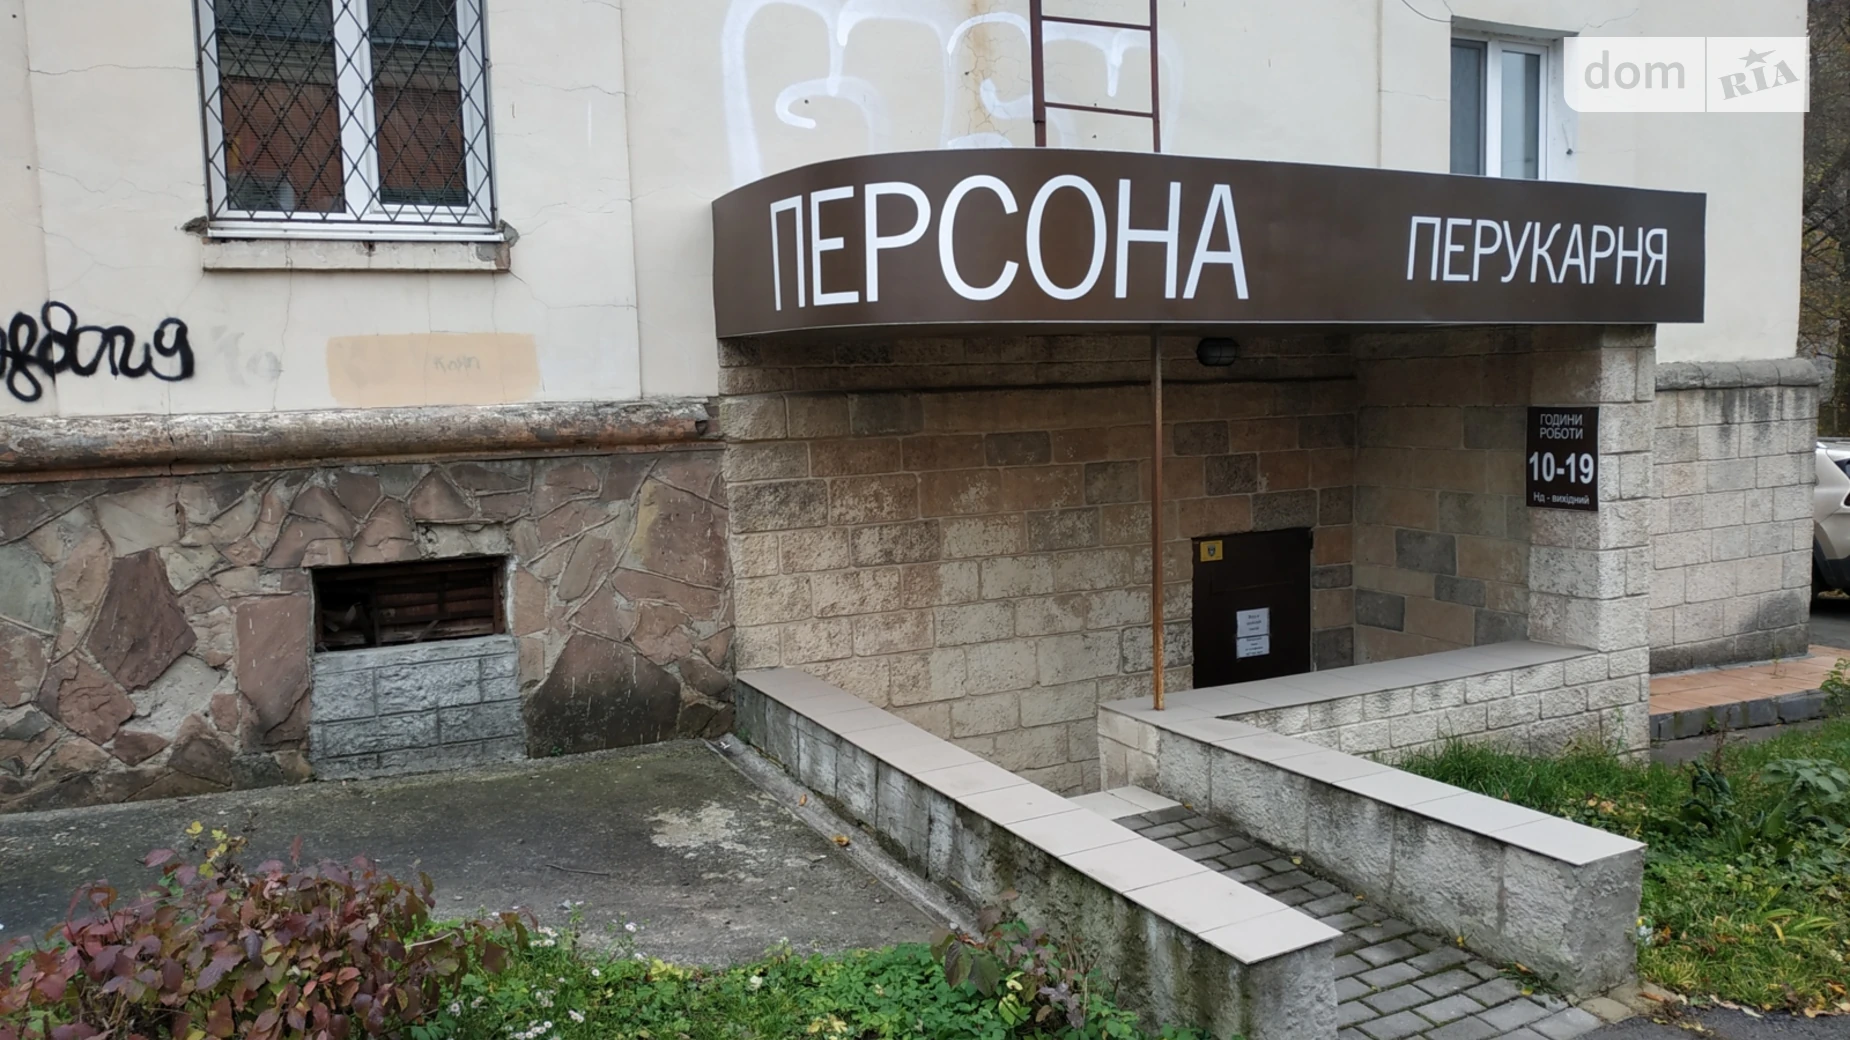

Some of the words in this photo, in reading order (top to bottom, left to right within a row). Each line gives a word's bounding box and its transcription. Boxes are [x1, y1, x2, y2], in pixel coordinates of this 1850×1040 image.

[769, 174, 1250, 311] ПЕРСОНА
[1405, 215, 1669, 286] ПЕРУКАРНЯ
[1540, 413, 1583, 427] ГОДИНИ
[1539, 428, 1584, 439] РОБОТИ
[1528, 451, 1594, 484] 10-19
[1551, 494, 1590, 505] вихідний
